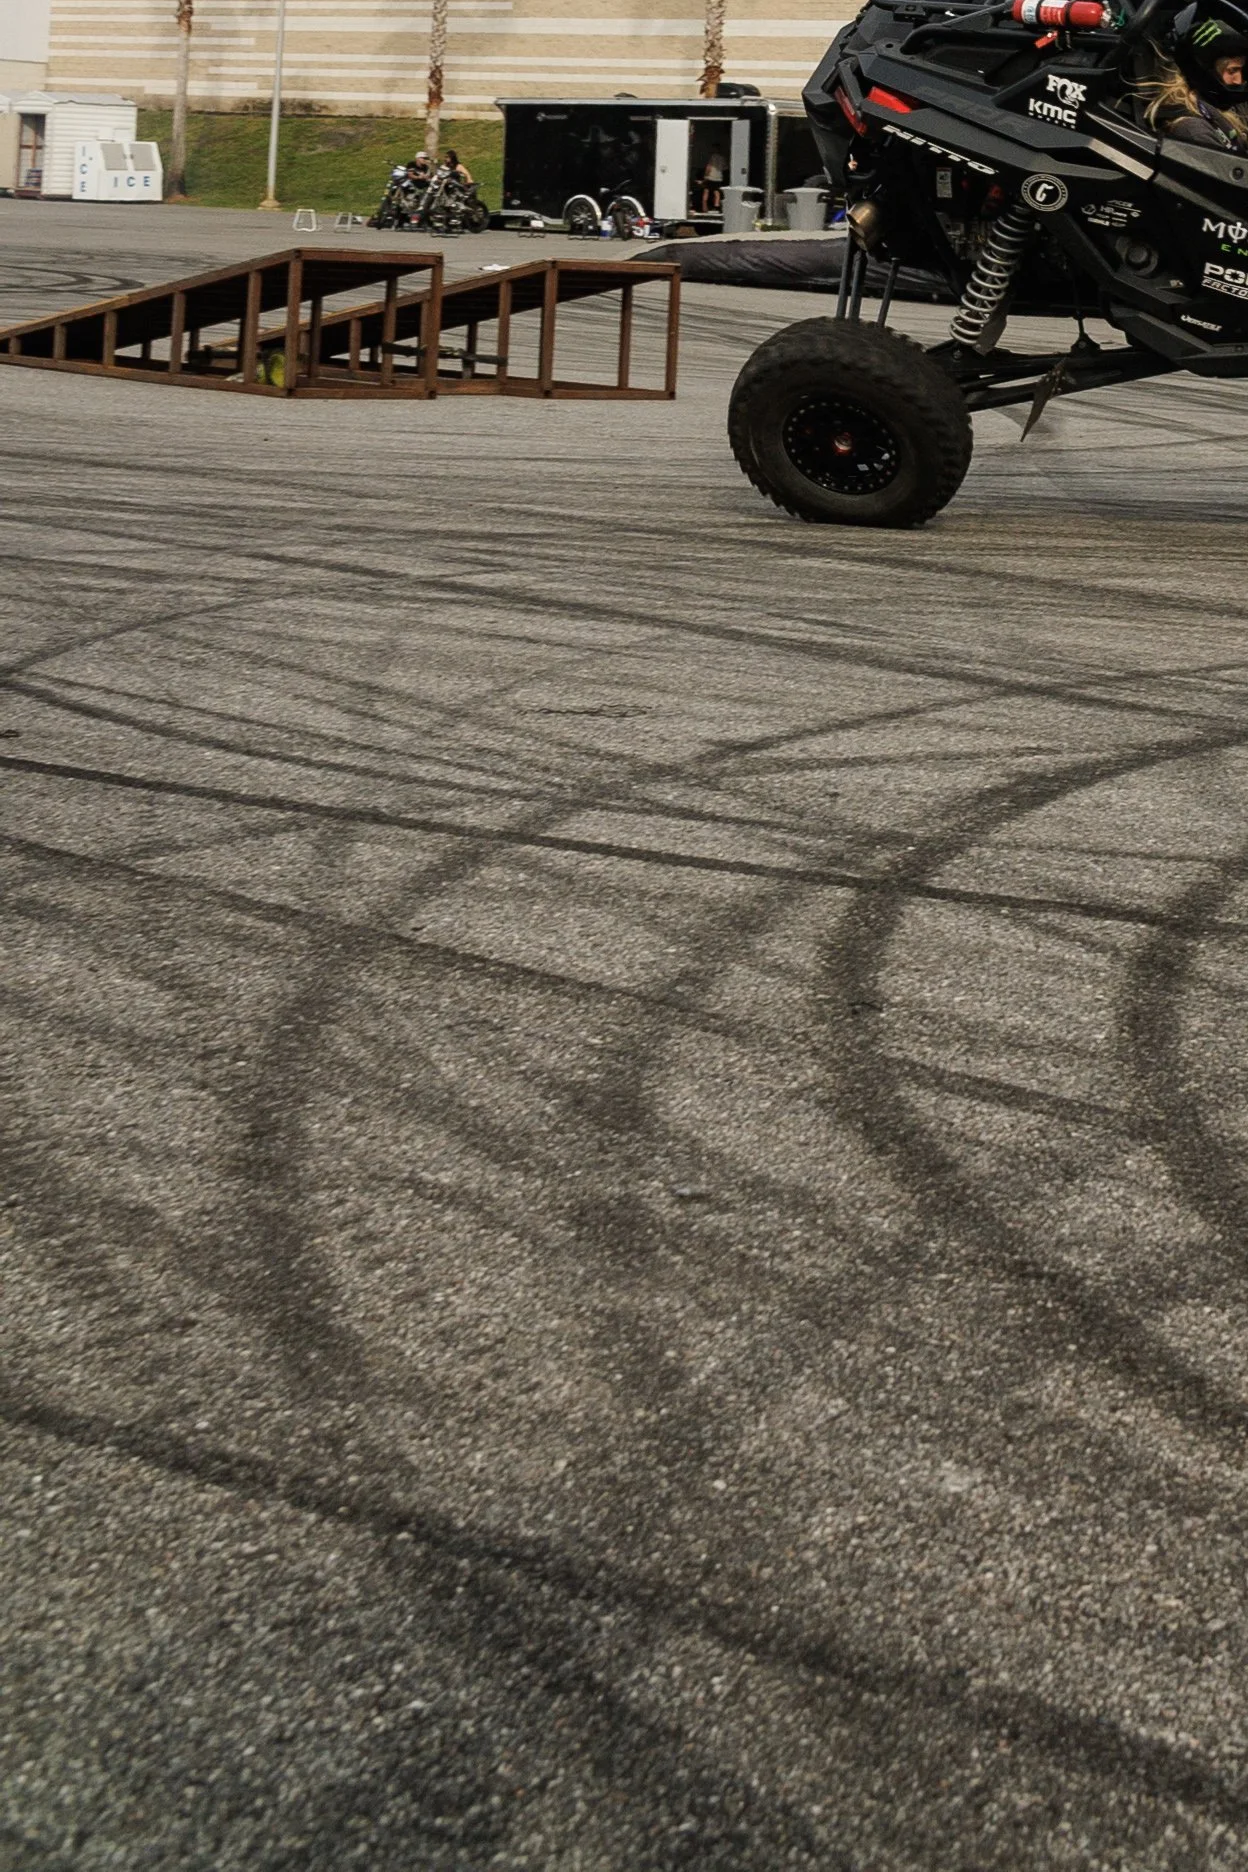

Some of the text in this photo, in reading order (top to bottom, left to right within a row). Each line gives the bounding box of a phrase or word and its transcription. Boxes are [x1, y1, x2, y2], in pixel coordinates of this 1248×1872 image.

[1046, 74, 1087, 109] FOX
[1028, 98, 1077, 124] KMC
[113, 175, 151, 188] ICE
